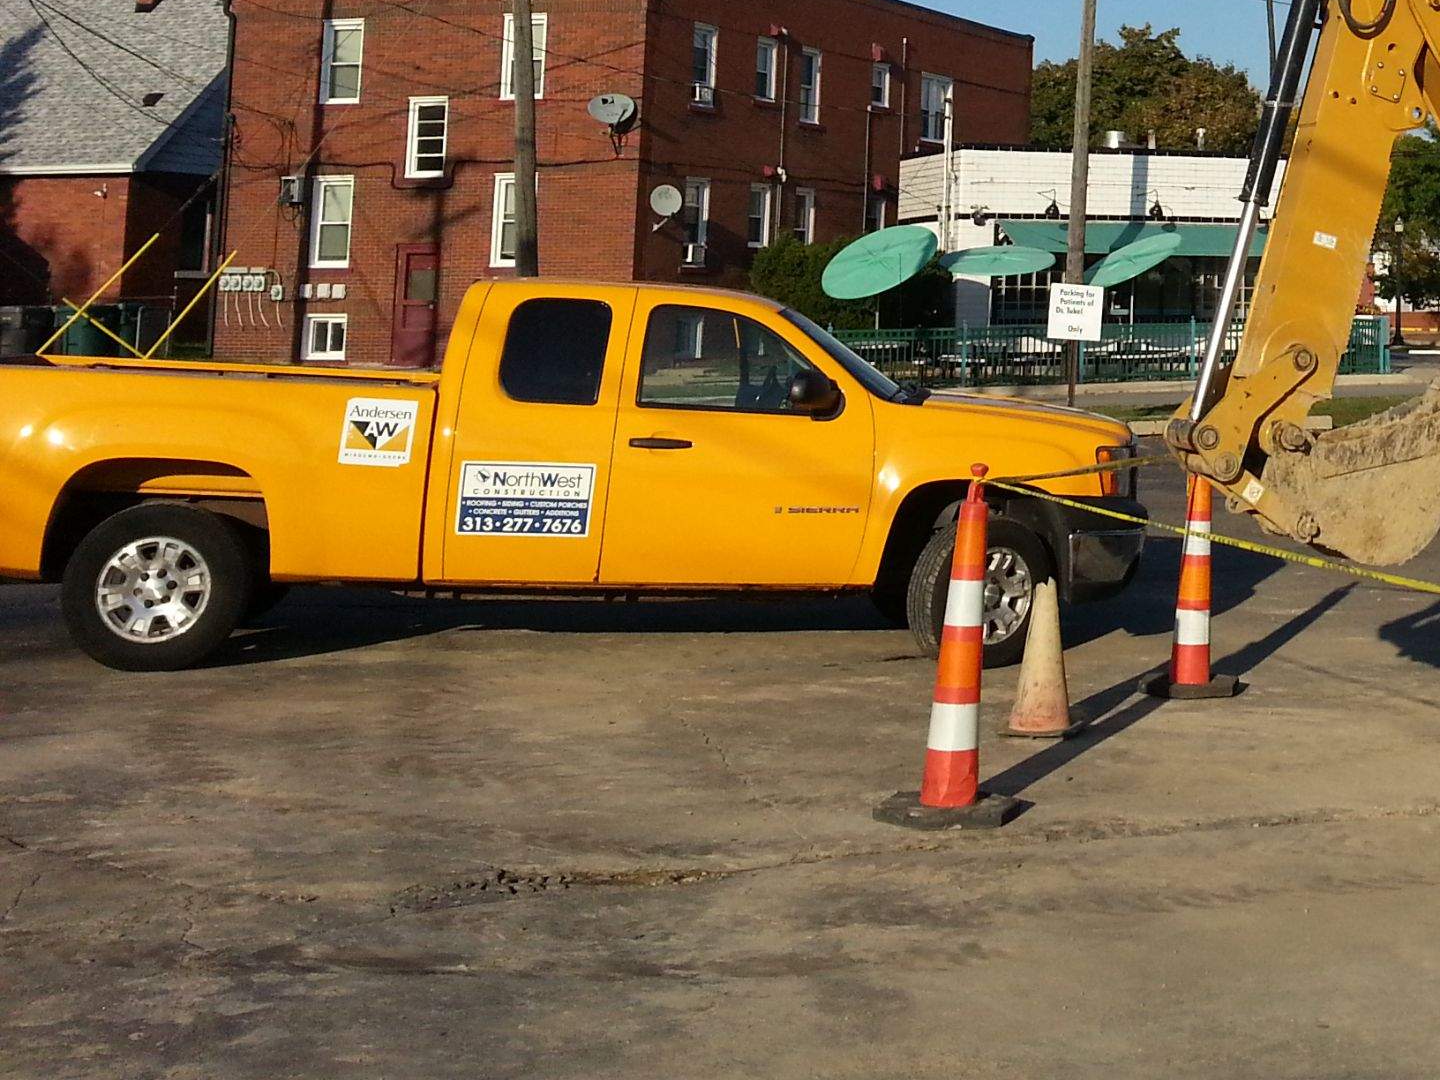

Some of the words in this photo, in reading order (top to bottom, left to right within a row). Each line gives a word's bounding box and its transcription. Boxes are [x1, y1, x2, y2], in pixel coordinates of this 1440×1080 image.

[1060, 289, 1084, 298] Parking
[349, 404, 412, 420] Andersen
[363, 421, 399, 437] AW
[493, 471, 583, 489] NorthWest
[473, 487, 580, 497] CONSTRUCTION
[473, 508, 507, 516] CONCRETE
